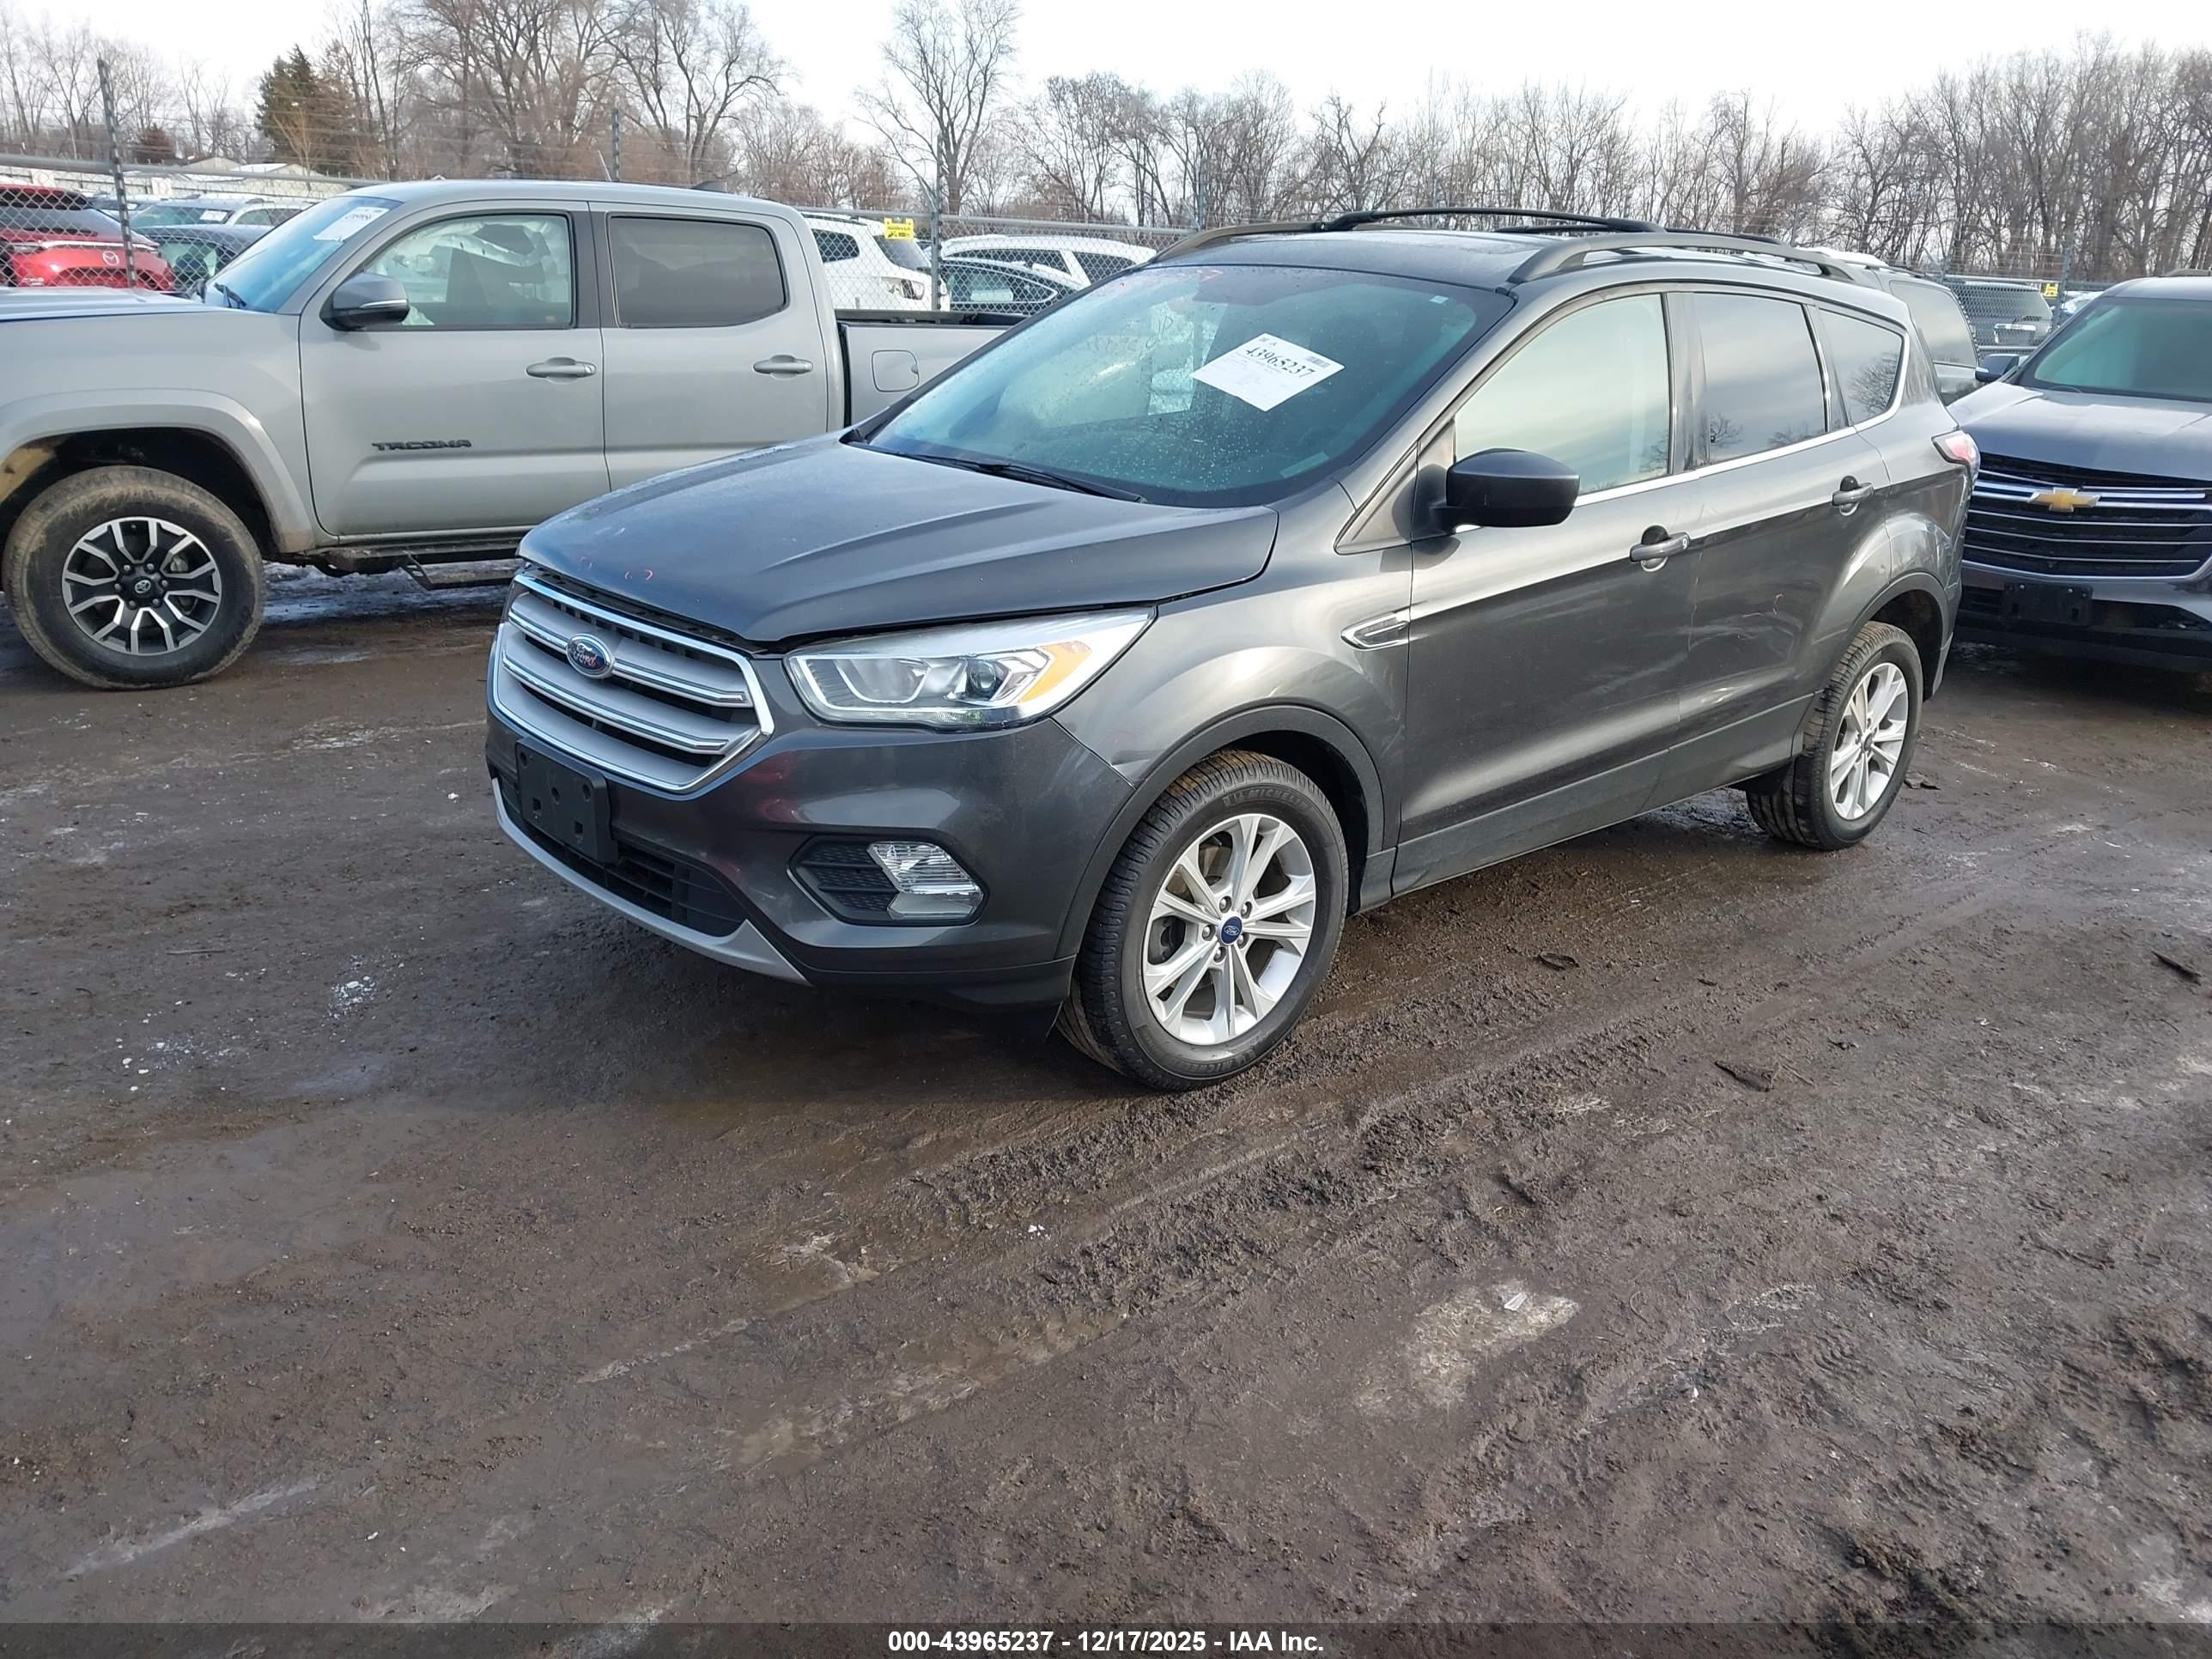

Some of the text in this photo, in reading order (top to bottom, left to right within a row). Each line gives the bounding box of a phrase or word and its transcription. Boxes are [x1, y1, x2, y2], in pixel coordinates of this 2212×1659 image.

[1245, 345, 1316, 379] 43965237
[372, 439, 472, 452] TACOMA
[1248, 787, 1312, 811] MICHELIN
